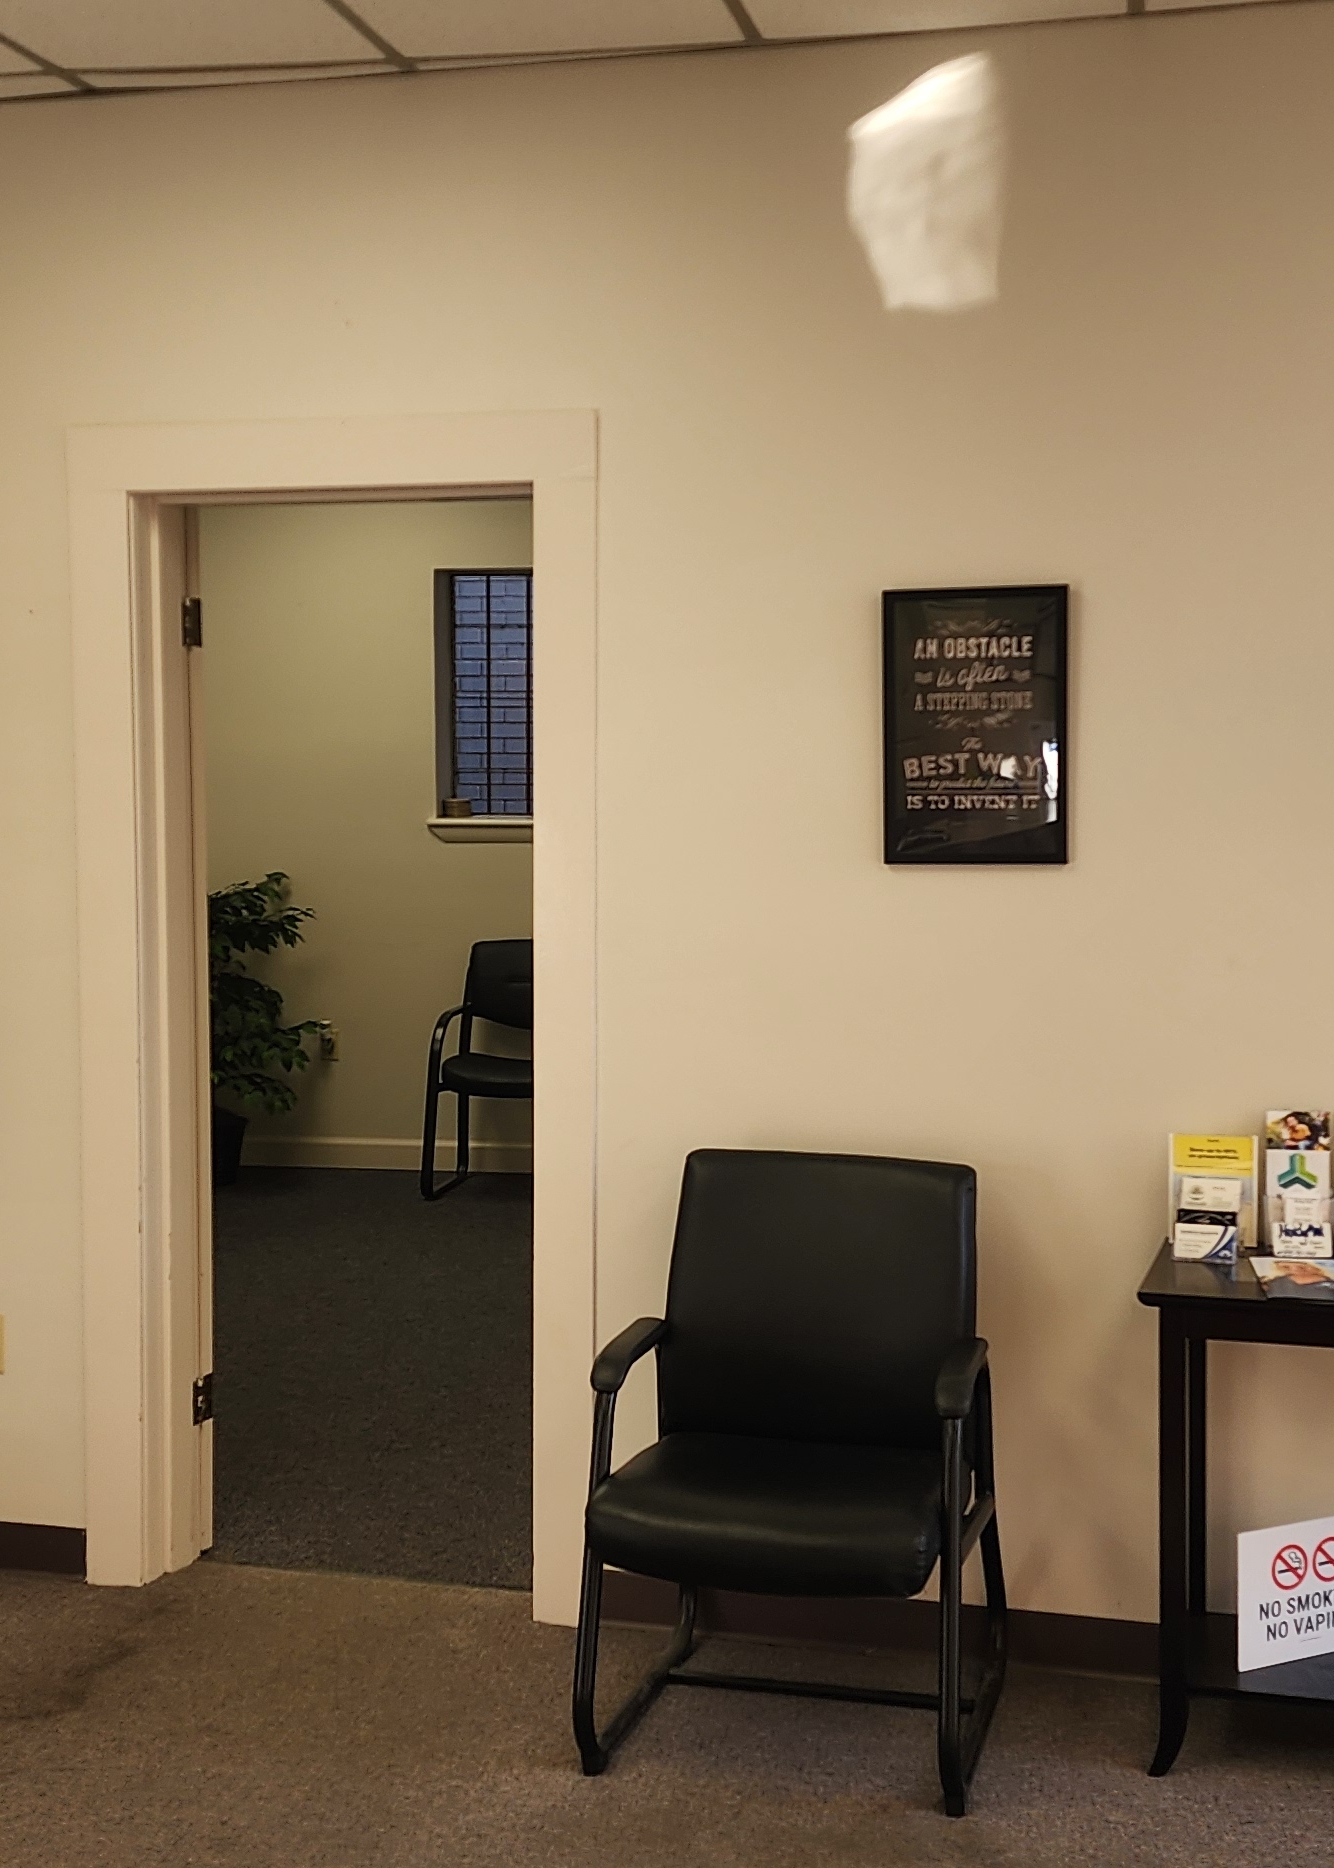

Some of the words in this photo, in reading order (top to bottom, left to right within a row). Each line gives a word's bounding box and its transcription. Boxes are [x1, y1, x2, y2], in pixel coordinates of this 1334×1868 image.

[913, 637, 939, 660] AN
[943, 635, 1033, 659] OBSTACLE
[936, 667, 955, 688] is
[957, 661, 1010, 691] often
[914, 693, 924, 711] A
[926, 692, 988, 710] STEPPING
[989, 691, 1033, 710] STONE
[903, 752, 970, 780] BEST
[977, 752, 1042, 778] WAY
[906, 794, 924, 810] IS
[927, 794, 949, 810] TO
[953, 794, 1018, 810] INVENT
[1021, 794, 1041, 810] IT
[1259, 1600, 1281, 1621] NO
[1266, 1621, 1289, 1642] NO
